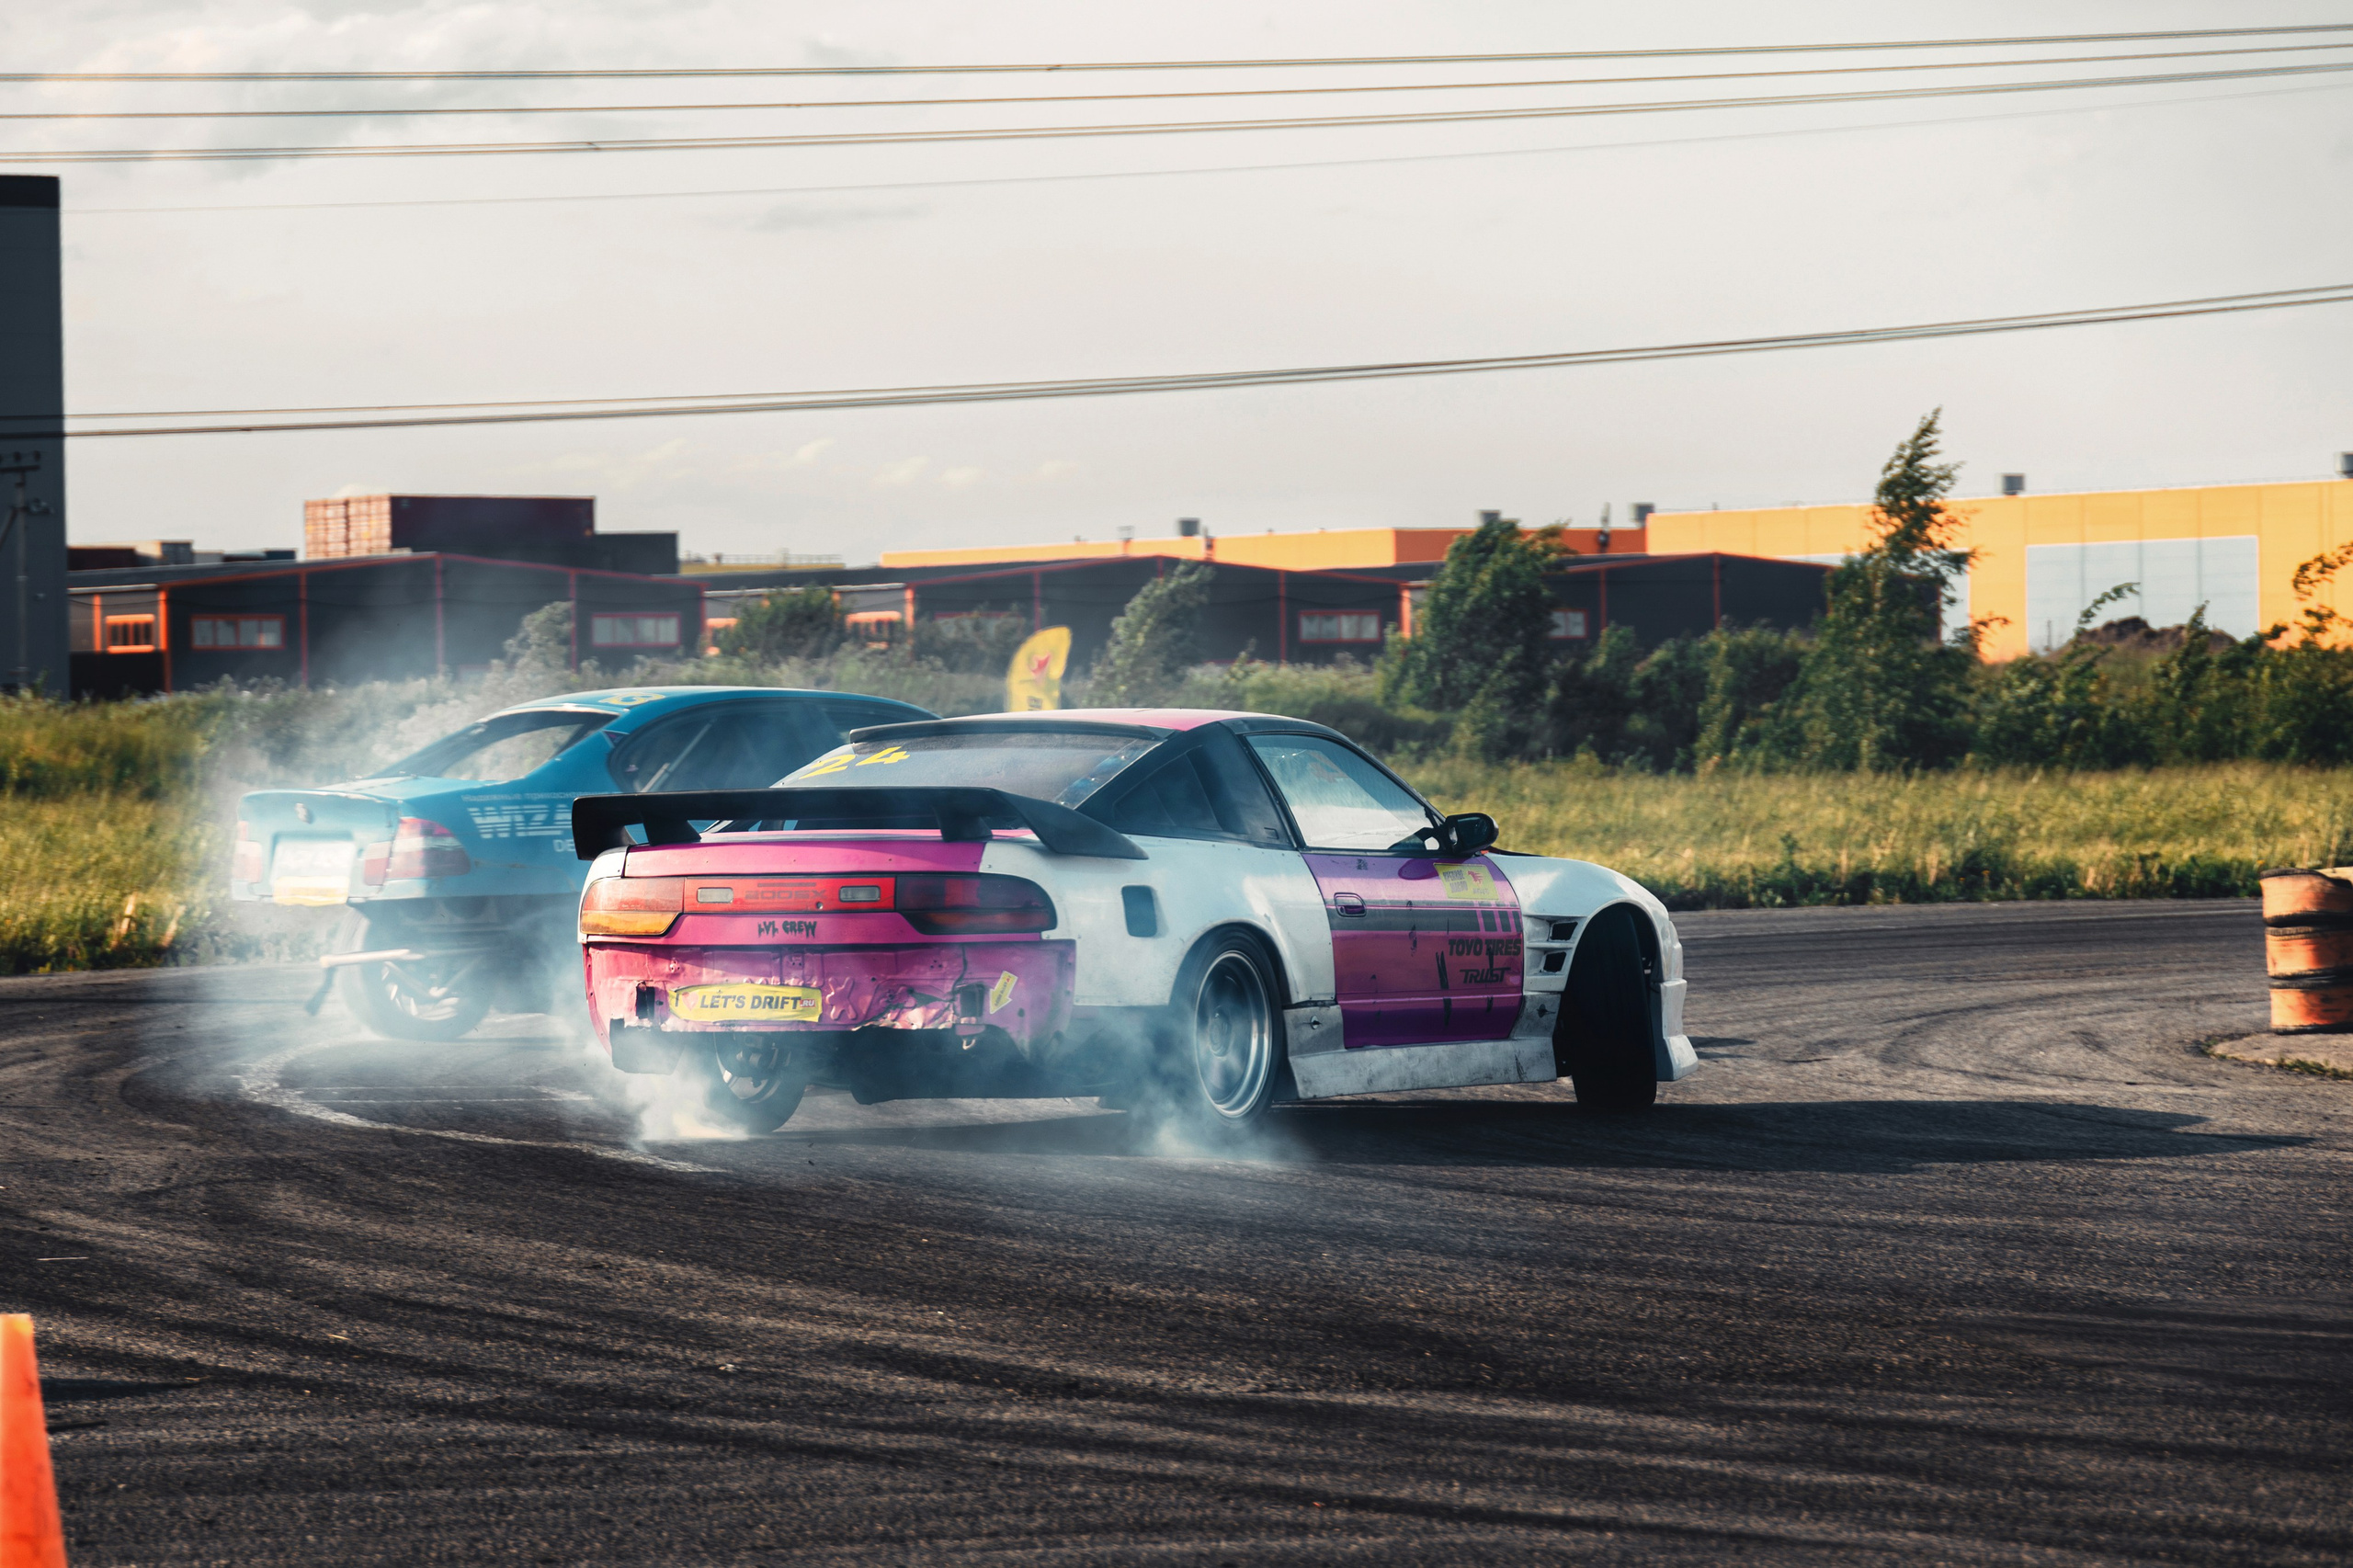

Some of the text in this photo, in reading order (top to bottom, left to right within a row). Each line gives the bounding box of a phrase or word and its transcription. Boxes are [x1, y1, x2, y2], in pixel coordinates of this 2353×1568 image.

[799, 745, 910, 779] 24
[467, 804, 572, 838] WIZA
[552, 839, 575, 852] DE
[782, 920, 817, 937] CREW
[1449, 938, 1521, 956] TOYO TIRES
[1460, 967, 1510, 983] TRUST
[700, 994, 745, 1008] LET'S
